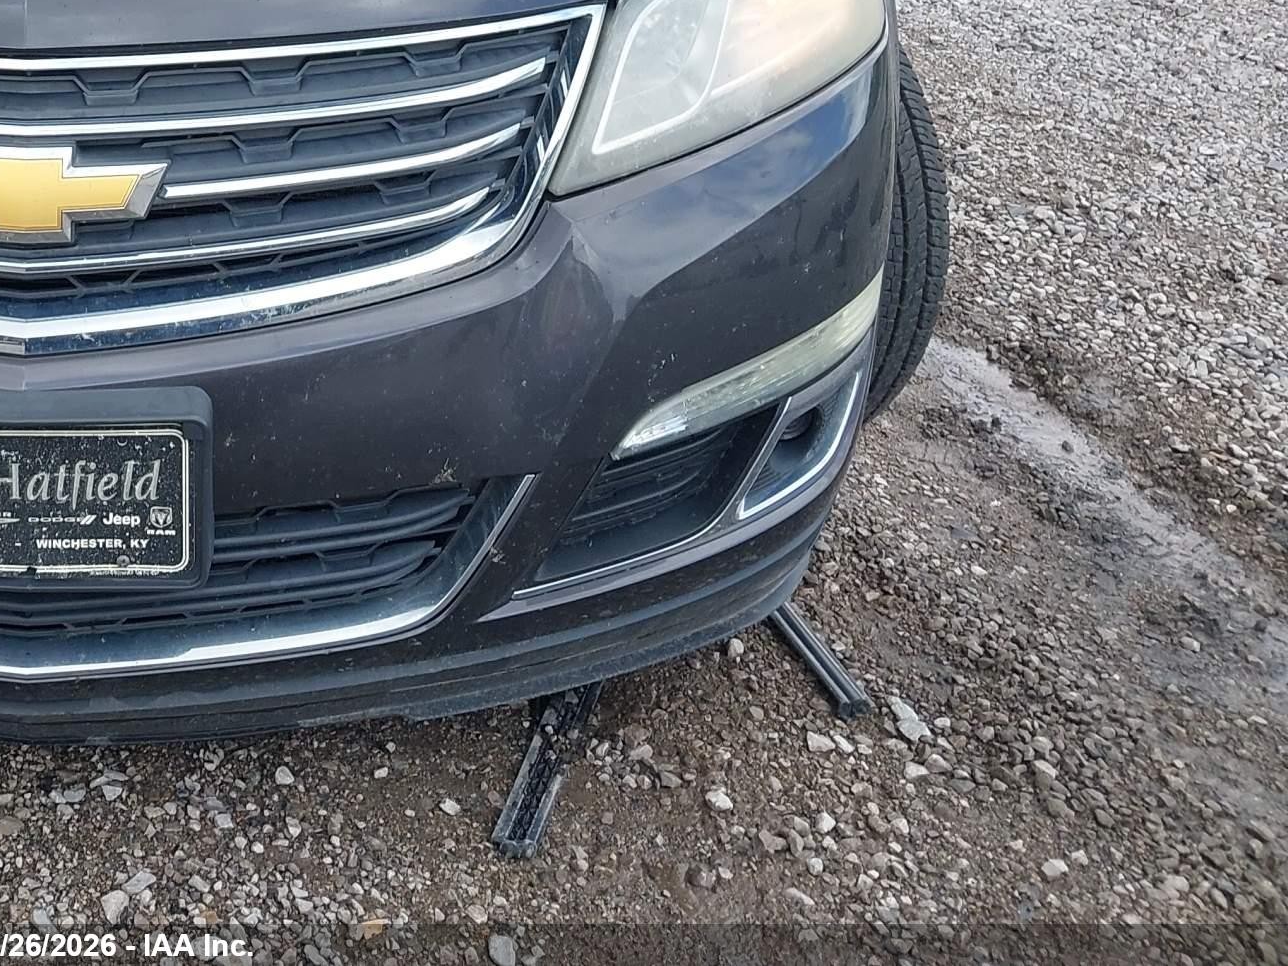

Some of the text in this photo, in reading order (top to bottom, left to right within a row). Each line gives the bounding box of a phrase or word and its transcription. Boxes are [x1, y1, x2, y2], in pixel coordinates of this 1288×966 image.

[103, 512, 141, 528] Jeep
[36, 538, 126, 550] WINCHESTER,
[130, 539, 150, 549] KY
